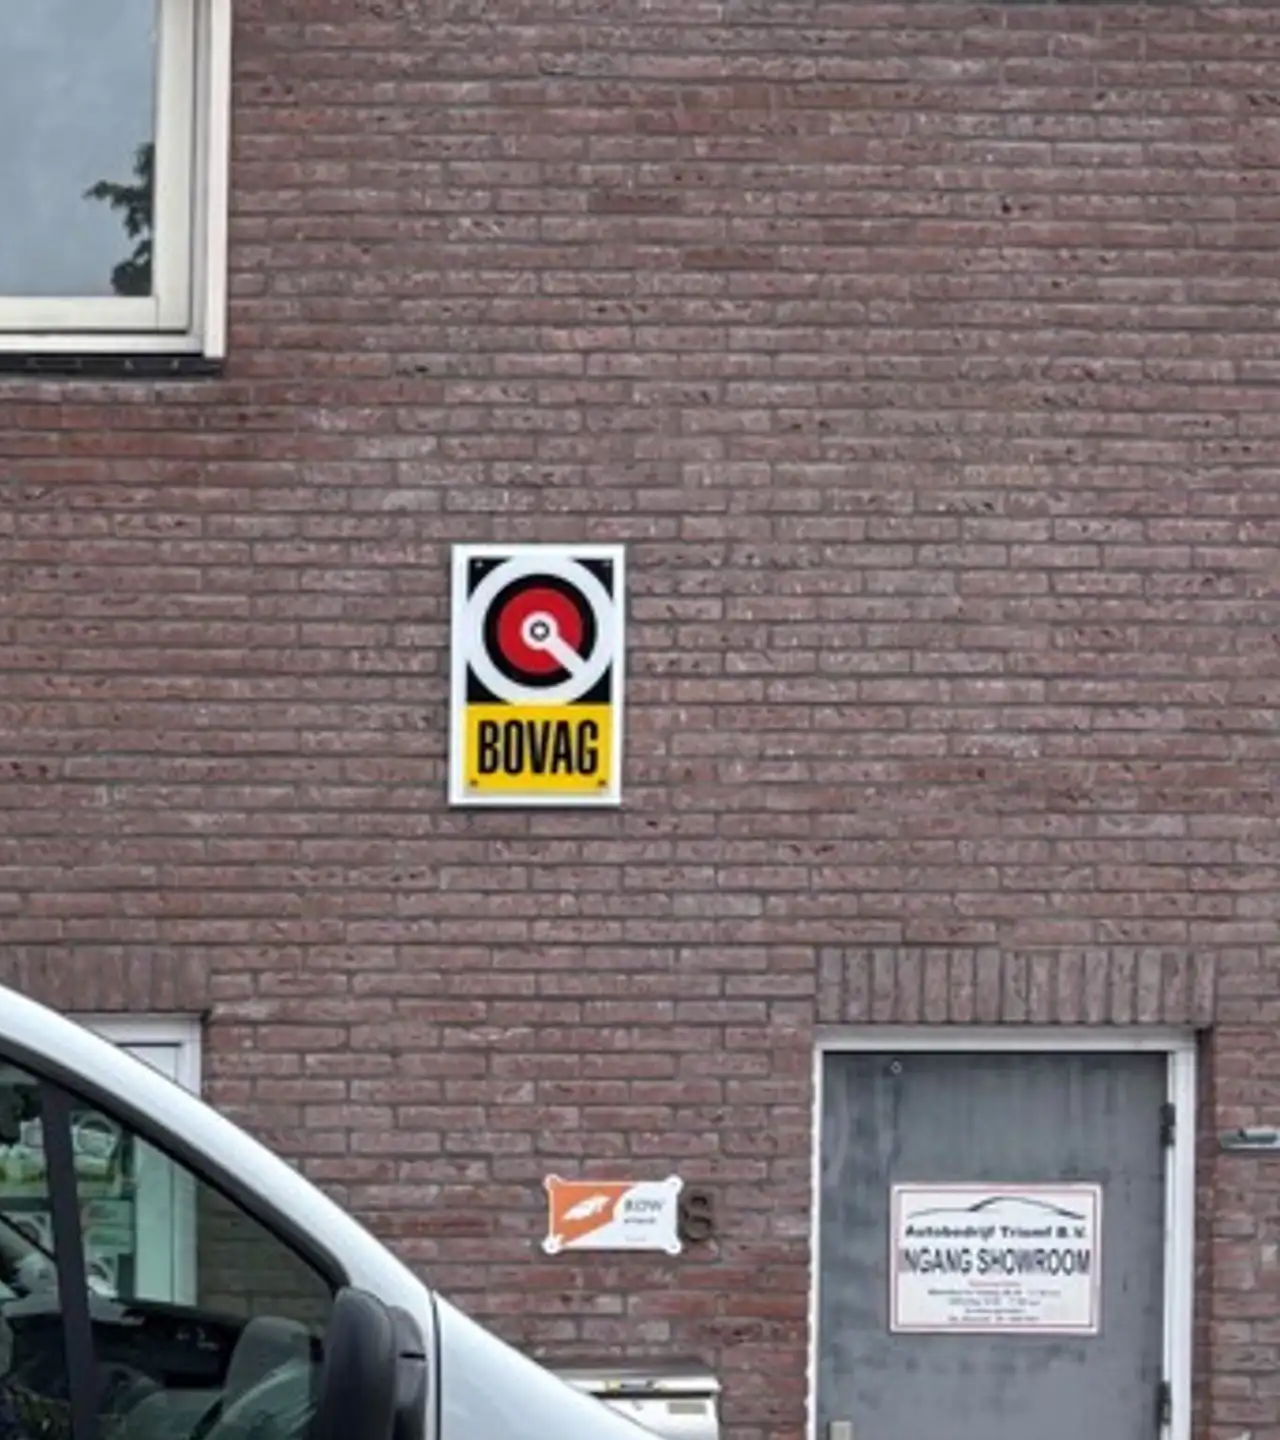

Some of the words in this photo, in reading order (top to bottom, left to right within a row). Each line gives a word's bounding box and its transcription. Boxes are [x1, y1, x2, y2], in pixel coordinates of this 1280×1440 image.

[477, 719, 599, 776] BOVAG
[905, 1225, 995, 1241] Autobedrijf
[1000, 1226, 1053, 1239] Triomf
[976, 1248, 1091, 1275] SHOWROOM
